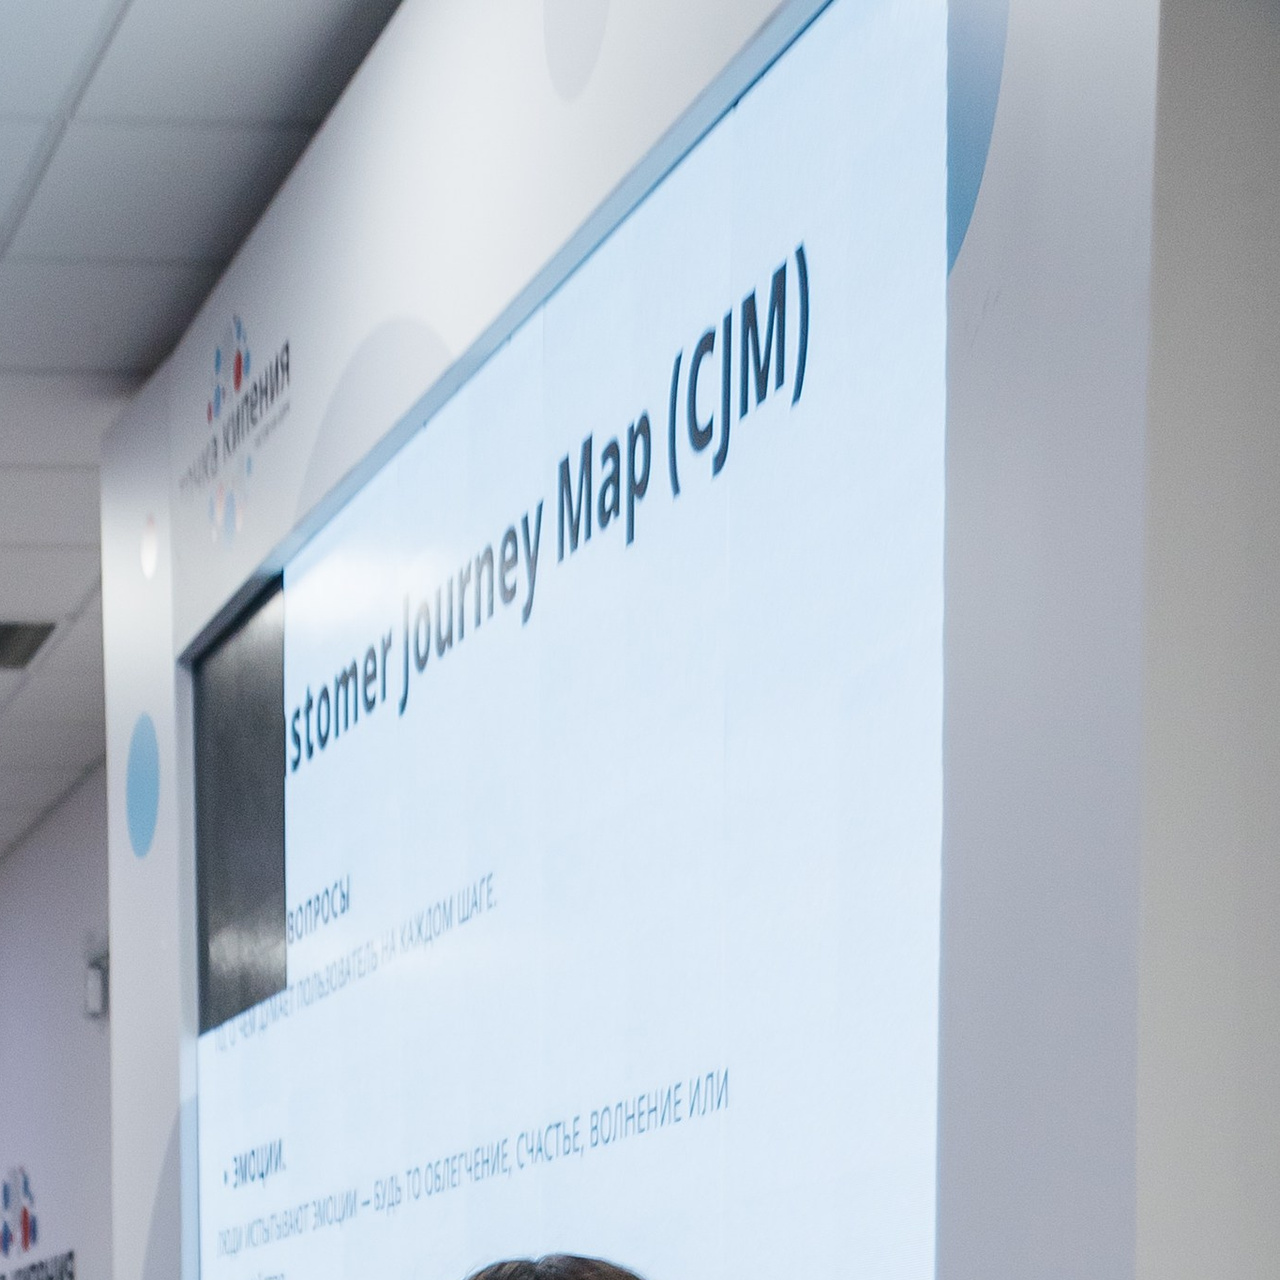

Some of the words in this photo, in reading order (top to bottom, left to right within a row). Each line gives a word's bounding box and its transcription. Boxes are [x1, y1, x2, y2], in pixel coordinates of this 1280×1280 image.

[290, 627, 394, 773] stomer
[398, 498, 544, 717] Journey
[556, 410, 652, 563] Map
[667, 241, 810, 498] (CJM)
[286, 874, 350, 945] ВОПРОСЫ
[400, 894, 454, 955] КАЖДОМ
[458, 871, 497, 924] ШАГЕ.
[233, 1138, 286, 1189] ЭМОЦИИ.
[373, 1174, 402, 1217] БУДЬ
[406, 1166, 421, 1202] ТО
[424, 1137, 513, 1196] ОБЛЕГЧЕНИЕ,
[516, 1115, 584, 1170] СЧАСТЬЕ,
[590, 1081, 682, 1148] ВОЛНЕНИЕ
[689, 1066, 729, 1119] ИЛИ
